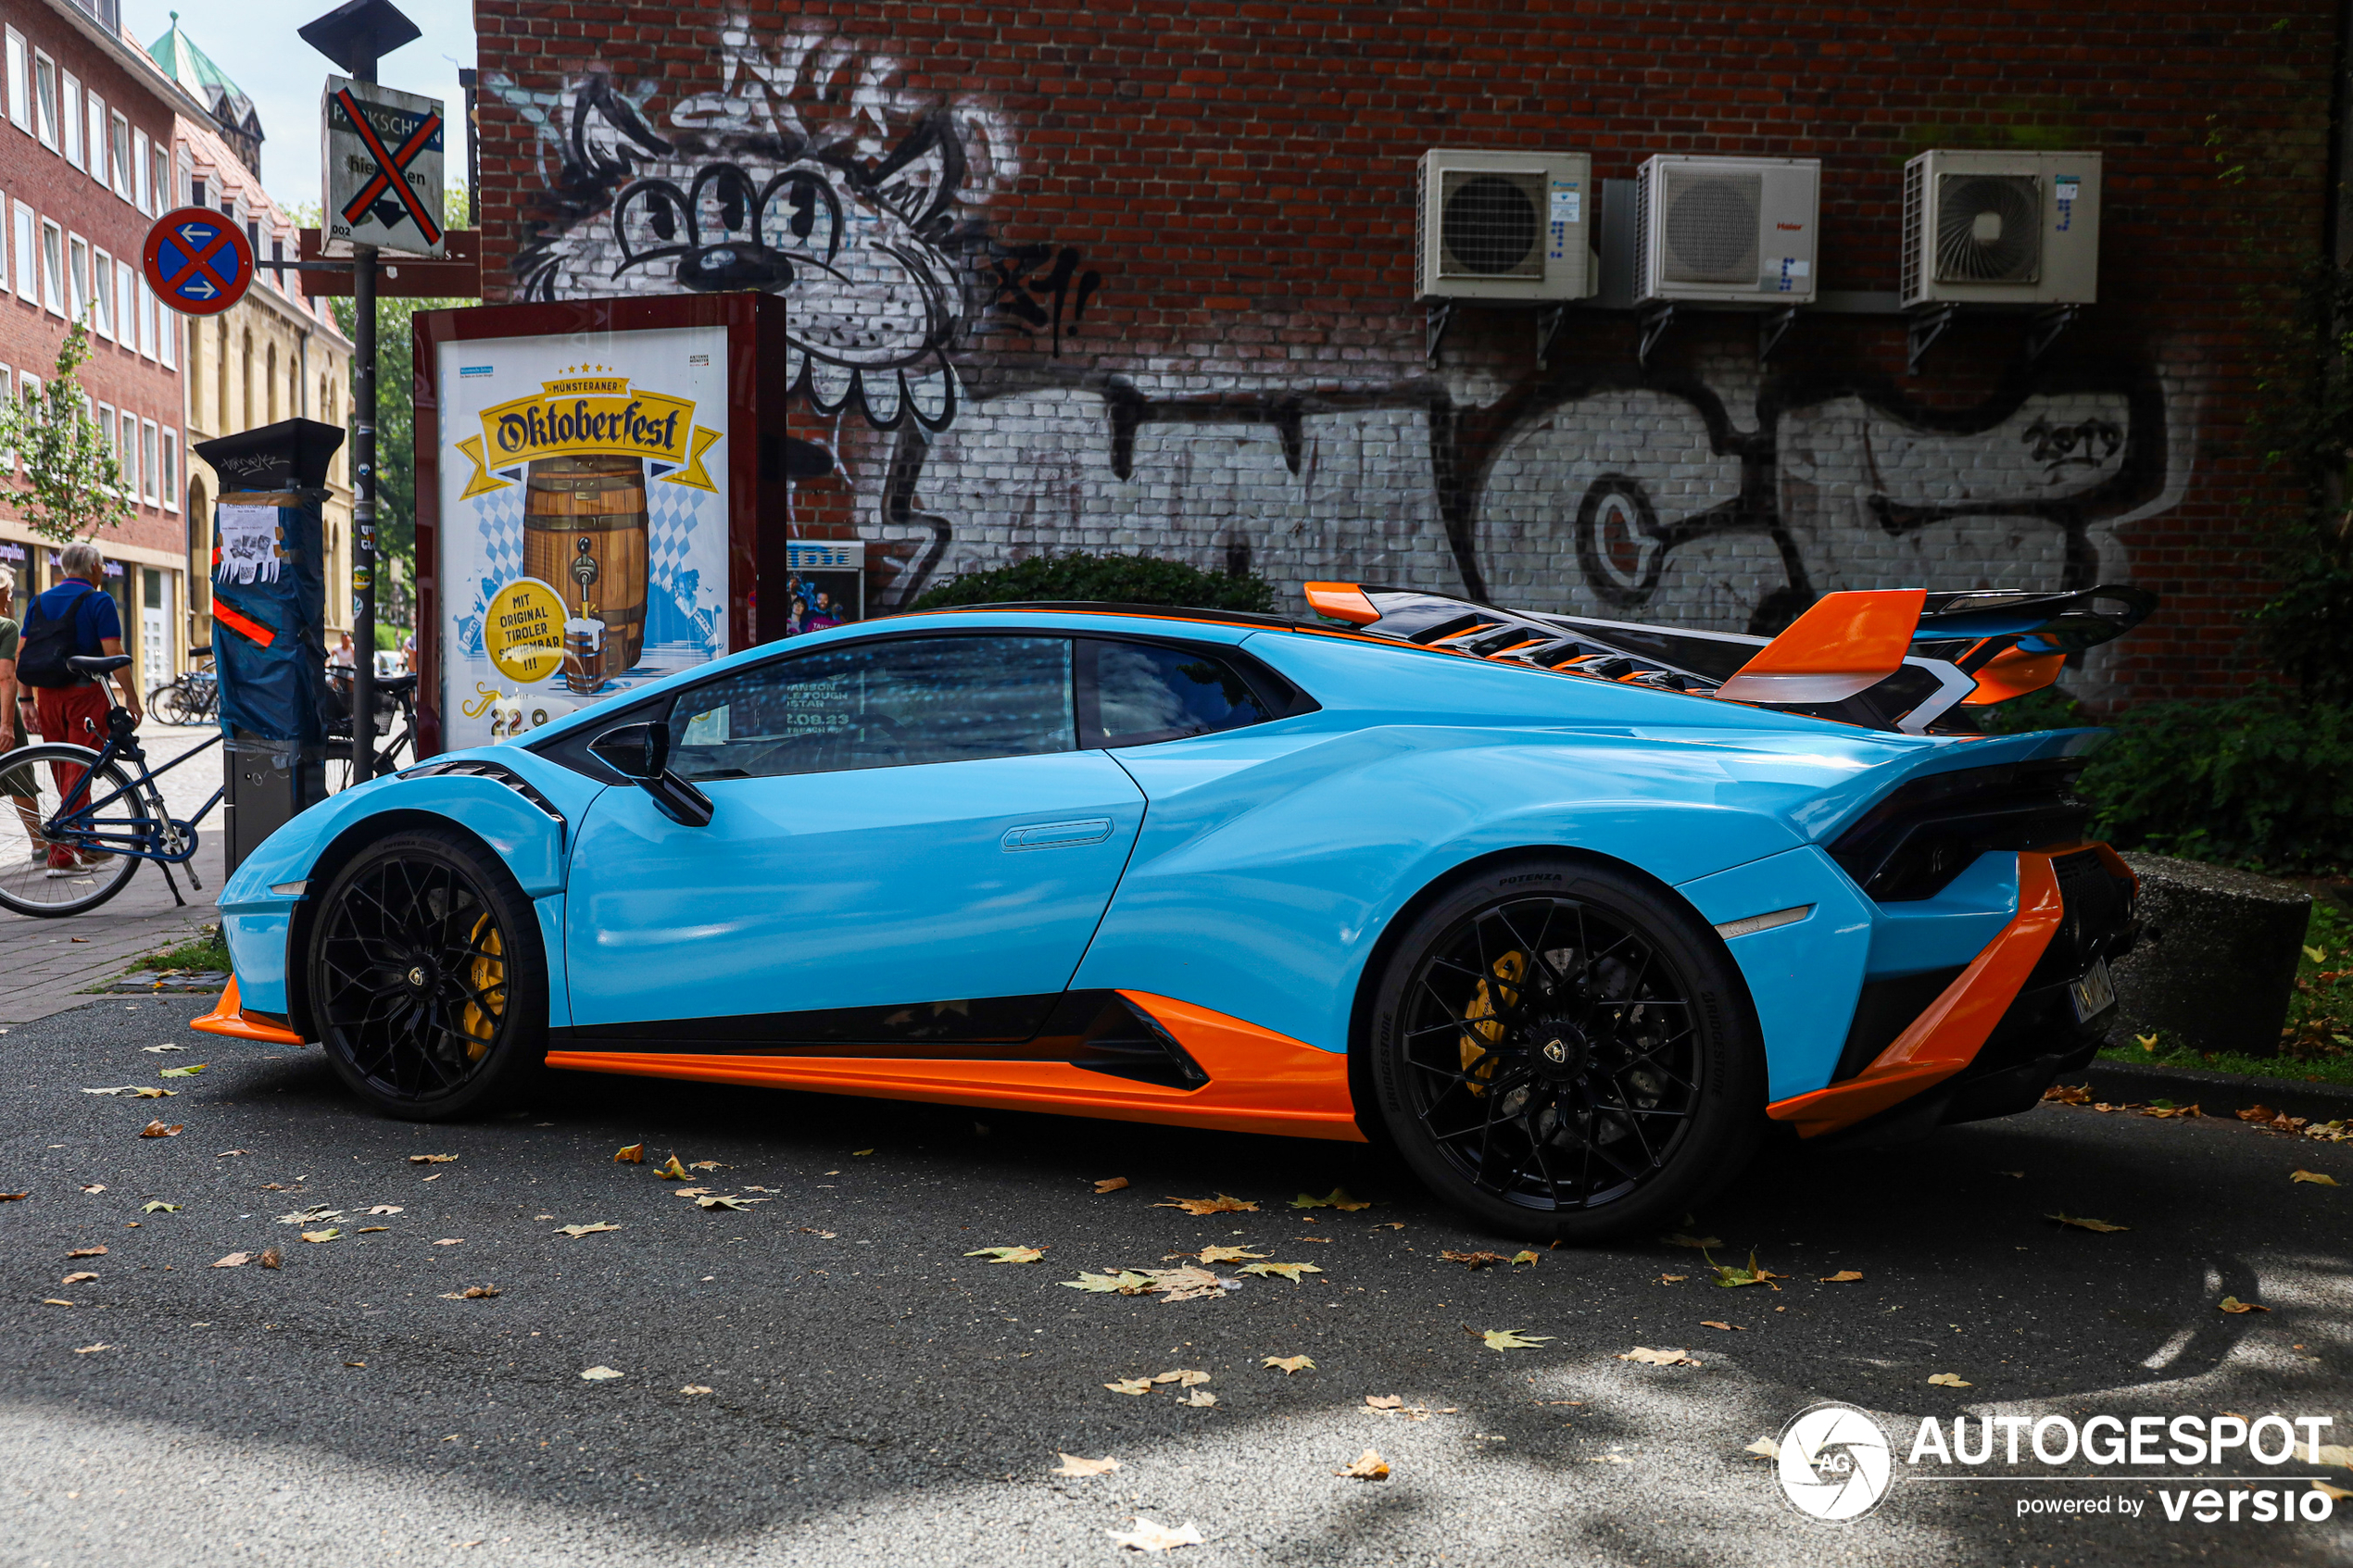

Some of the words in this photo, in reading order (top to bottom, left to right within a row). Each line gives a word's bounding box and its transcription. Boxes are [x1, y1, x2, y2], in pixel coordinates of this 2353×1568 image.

[332, 224, 351, 236] 002
[552, 381, 618, 394] MÜNSTERANER
[497, 398, 681, 454] Oktoberfest
[511, 593, 531, 609] MIT
[499, 606, 548, 628] ORIGINAL
[505, 622, 547, 644] TIROLER
[498, 636, 560, 660] SCHIRMBAR
[384, 840, 416, 849] POTENZA
[1499, 873, 1563, 886] POTENZA
[1701, 991, 1726, 1098] BRIDGESTONE
[1379, 1010, 1401, 1112] BRIDGESTONE
